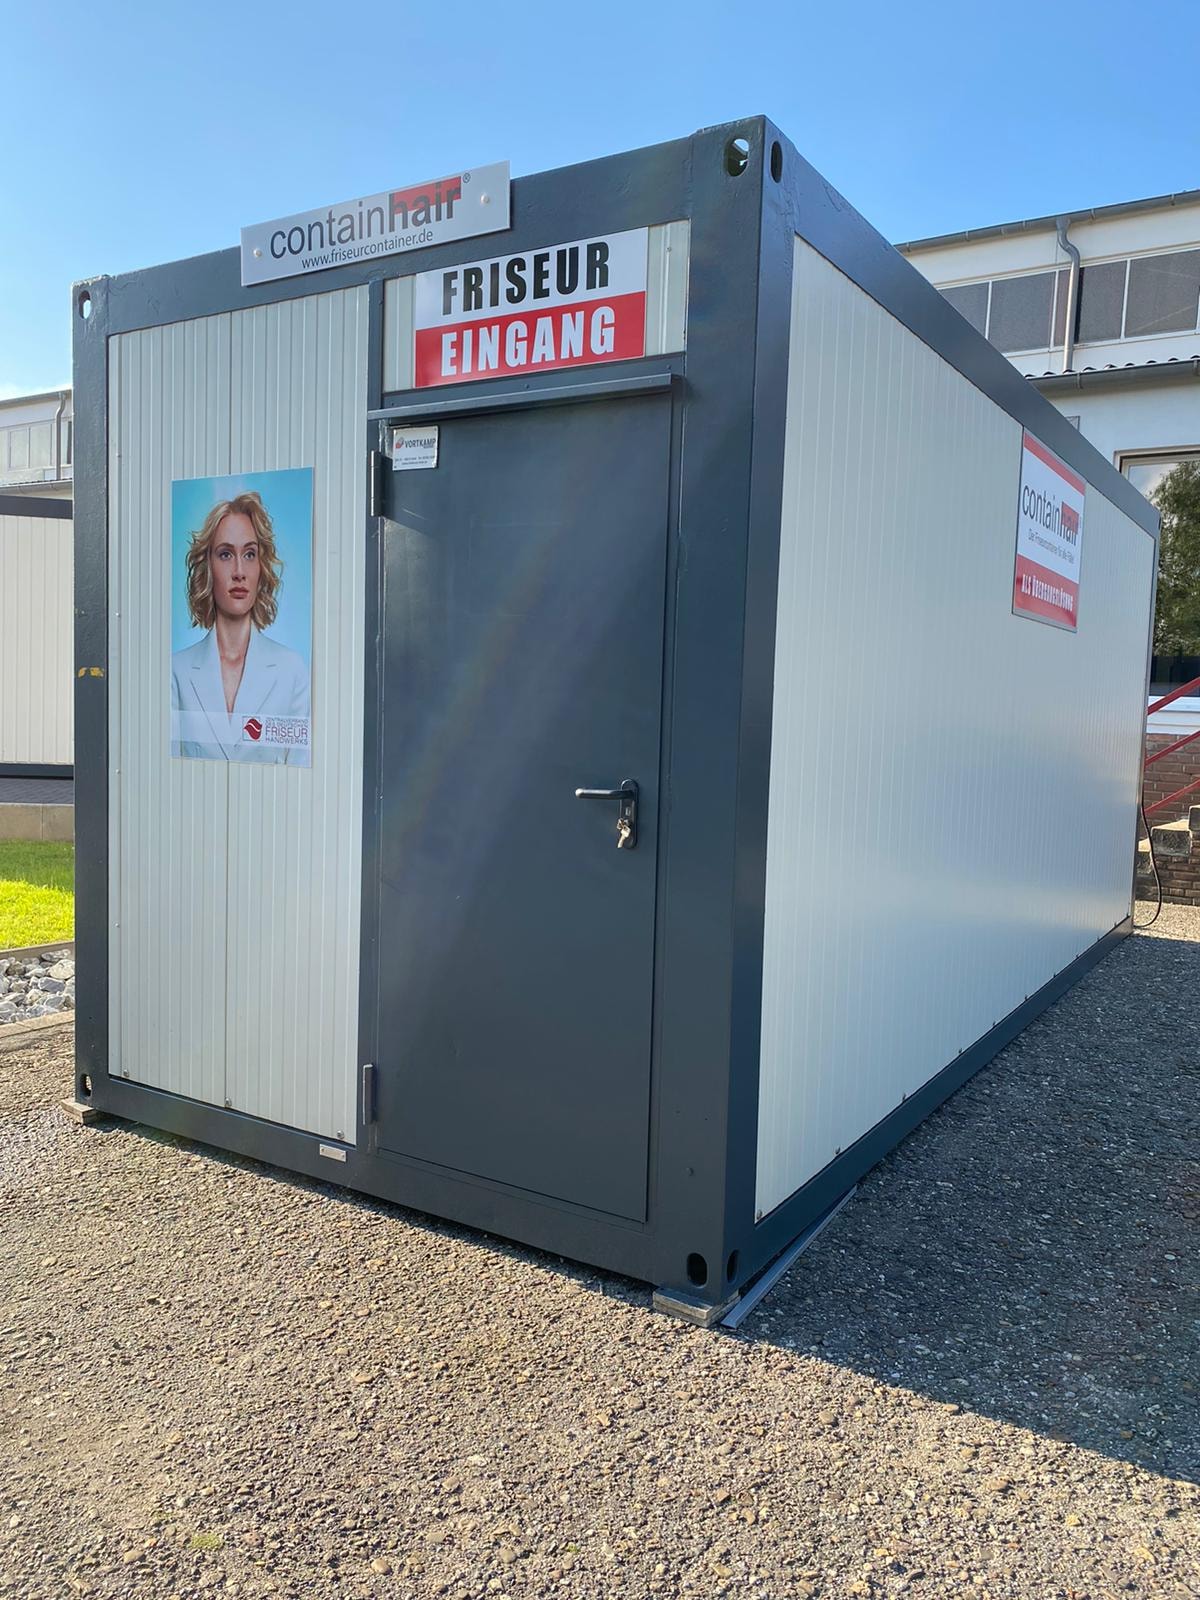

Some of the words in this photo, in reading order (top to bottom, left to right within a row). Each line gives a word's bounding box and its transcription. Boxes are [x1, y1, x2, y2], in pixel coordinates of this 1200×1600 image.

[302, 229, 433, 269] www.friseurcontainer.de
[442, 241, 610, 316] FRISEUR
[441, 306, 616, 377] EINGANG
[404, 438, 437, 449] VORTKAMP
[1021, 573, 1031, 596] ALS
[265, 726, 308, 738] FRISEUR
[265, 737, 308, 746] HANDWERKS
